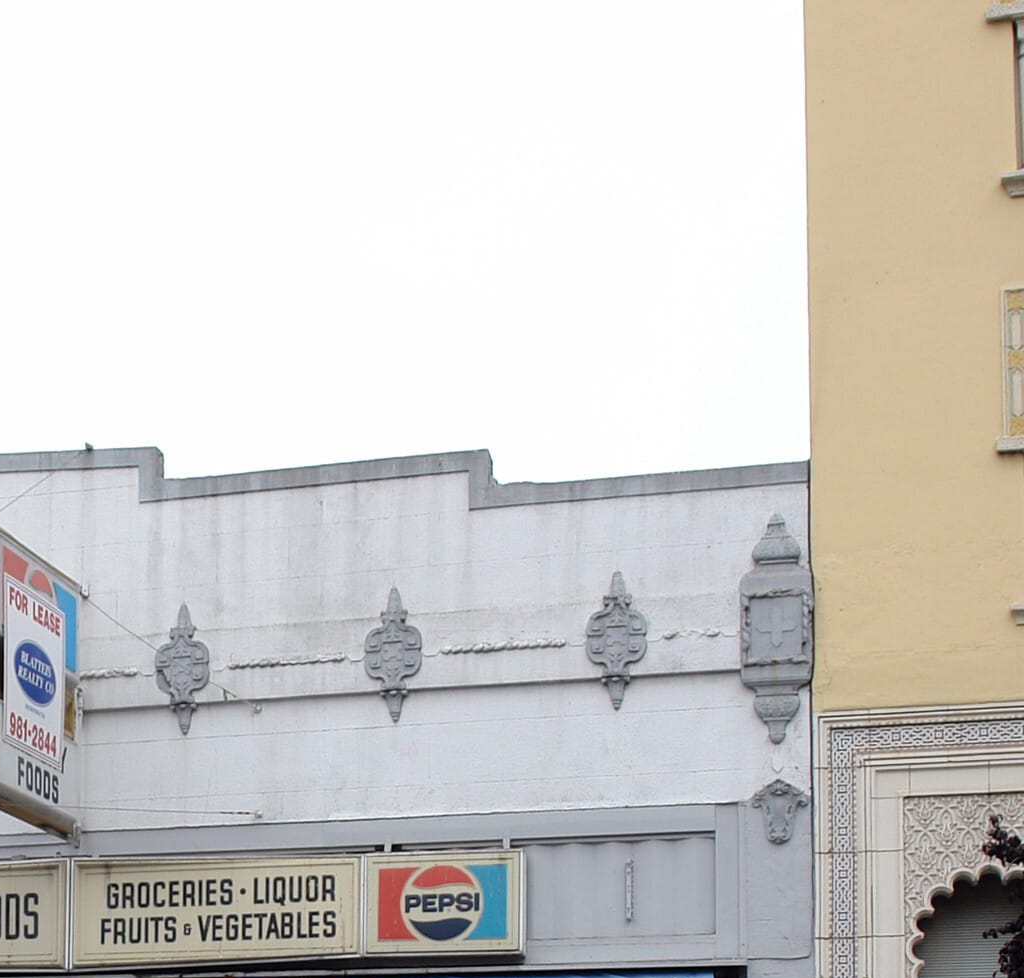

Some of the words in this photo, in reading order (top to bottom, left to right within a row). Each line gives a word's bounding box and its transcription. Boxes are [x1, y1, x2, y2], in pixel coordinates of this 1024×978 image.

[8, 586, 28, 616] FOR
[32, 602, 61, 637] LEASE
[17, 665, 44, 690] REALTY
[44, 680, 55, 696] CO
[9, 712, 57, 757] 981-2844
[17, 756, 59, 804] FOODS
[106, 878, 234, 909] GROCERIES
[253, 874, 337, 905] LIQUOR
[404, 892, 481, 914] PEPSI
[100, 916, 177, 945] FRUITS
[183, 923, 192, 937] &
[198, 910, 337, 942] VEGETABLES
